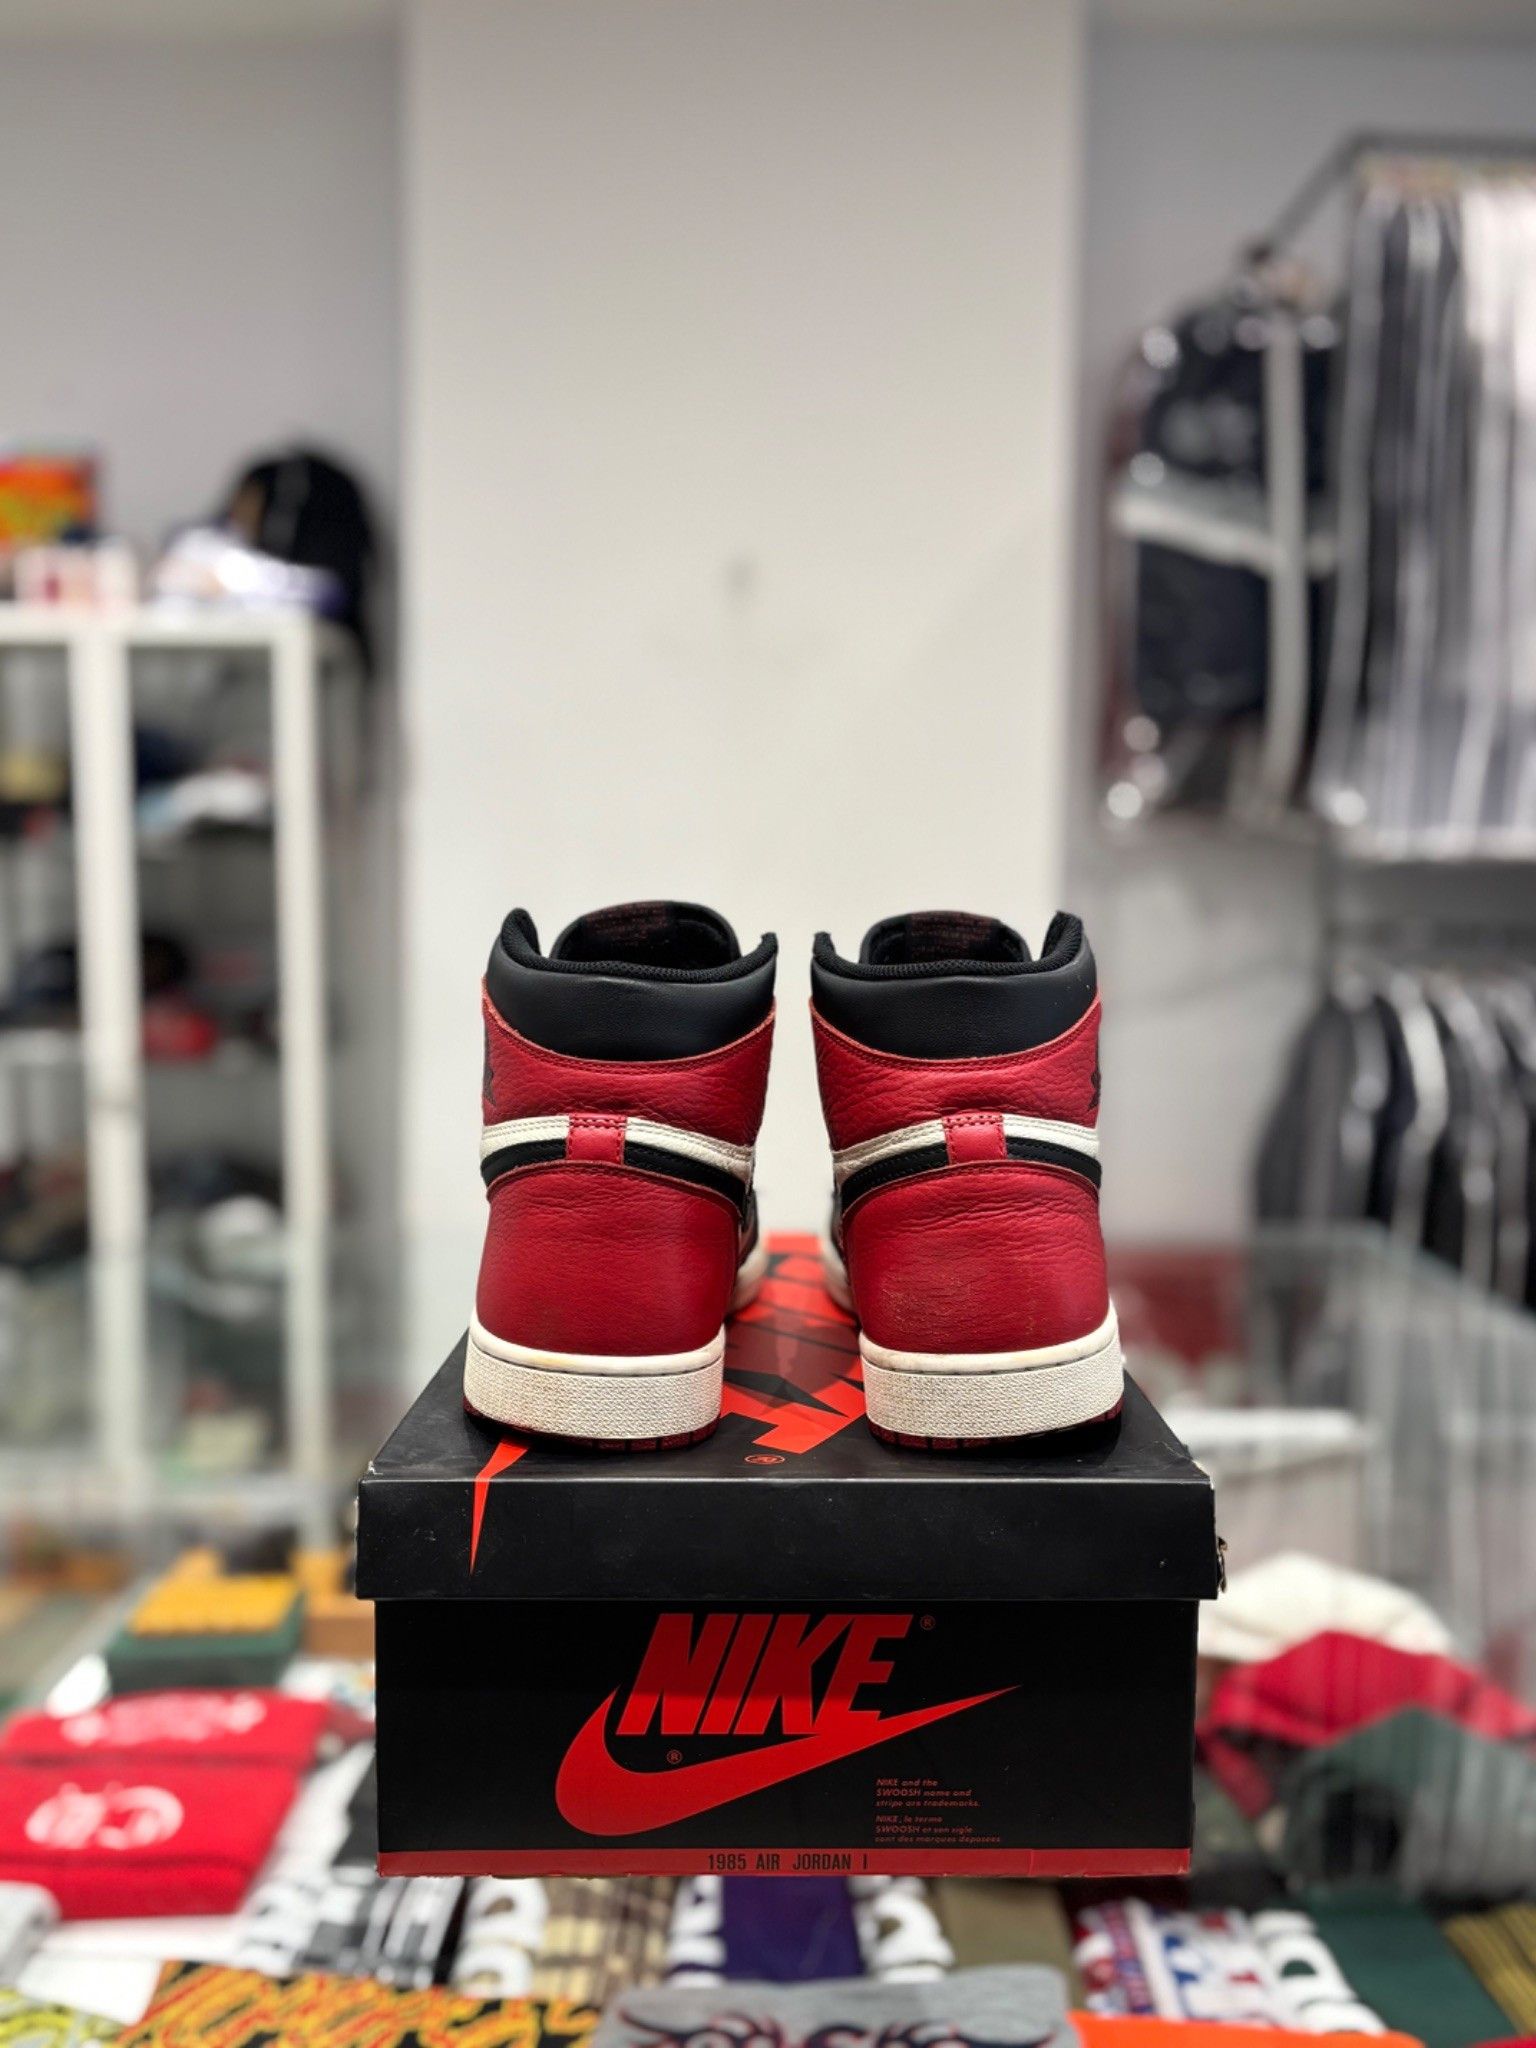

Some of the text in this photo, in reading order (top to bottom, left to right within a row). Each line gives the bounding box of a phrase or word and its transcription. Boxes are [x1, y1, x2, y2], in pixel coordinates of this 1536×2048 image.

[615, 1613, 913, 1735] NIKE
[876, 1778, 898, 1786] NIKE
[922, 1778, 938, 1786] the
[876, 1788, 920, 1797] SWOOSH
[952, 1789, 972, 1797] and
[875, 1825, 920, 1833] SWOOSH
[708, 1854, 868, 1870] 1985 AIR JORDAN I
